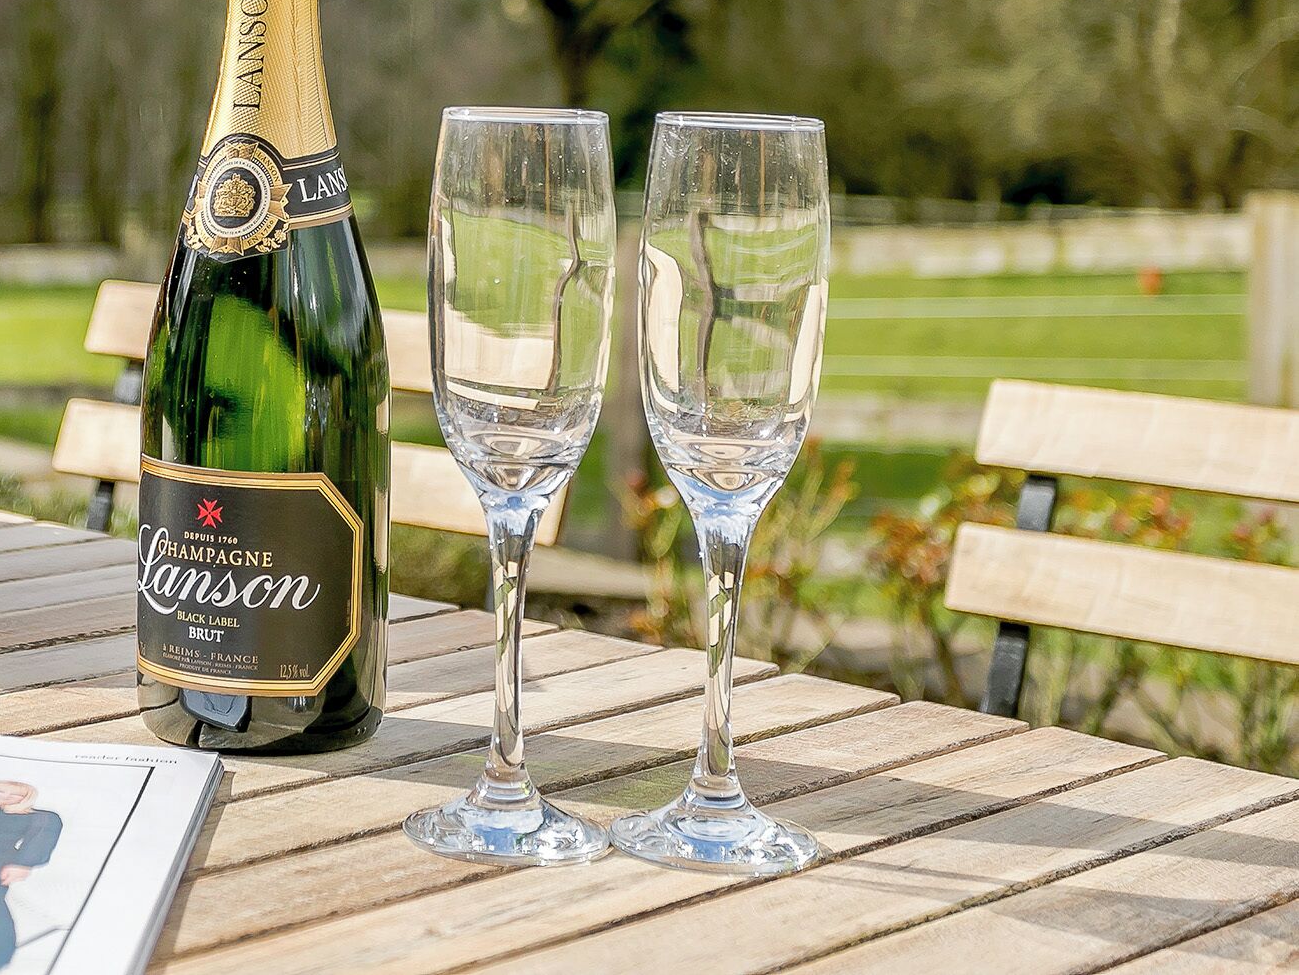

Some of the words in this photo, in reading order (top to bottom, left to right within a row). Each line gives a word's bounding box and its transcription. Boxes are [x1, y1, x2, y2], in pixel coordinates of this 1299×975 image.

[297, 162, 348, 202] LANS
[183, 531, 215, 543] DEPUIS
[217, 534, 238, 545] 1760
[158, 539, 273, 568] CHAMPAGNE
[138, 524, 321, 615] Lanson
[177, 610, 205, 624] BLACK
[208, 615, 240, 628] LABEL
[188, 626, 224, 643] BRUT
[168, 644, 200, 659] REIMS
[210, 652, 259, 665] FRANCE
